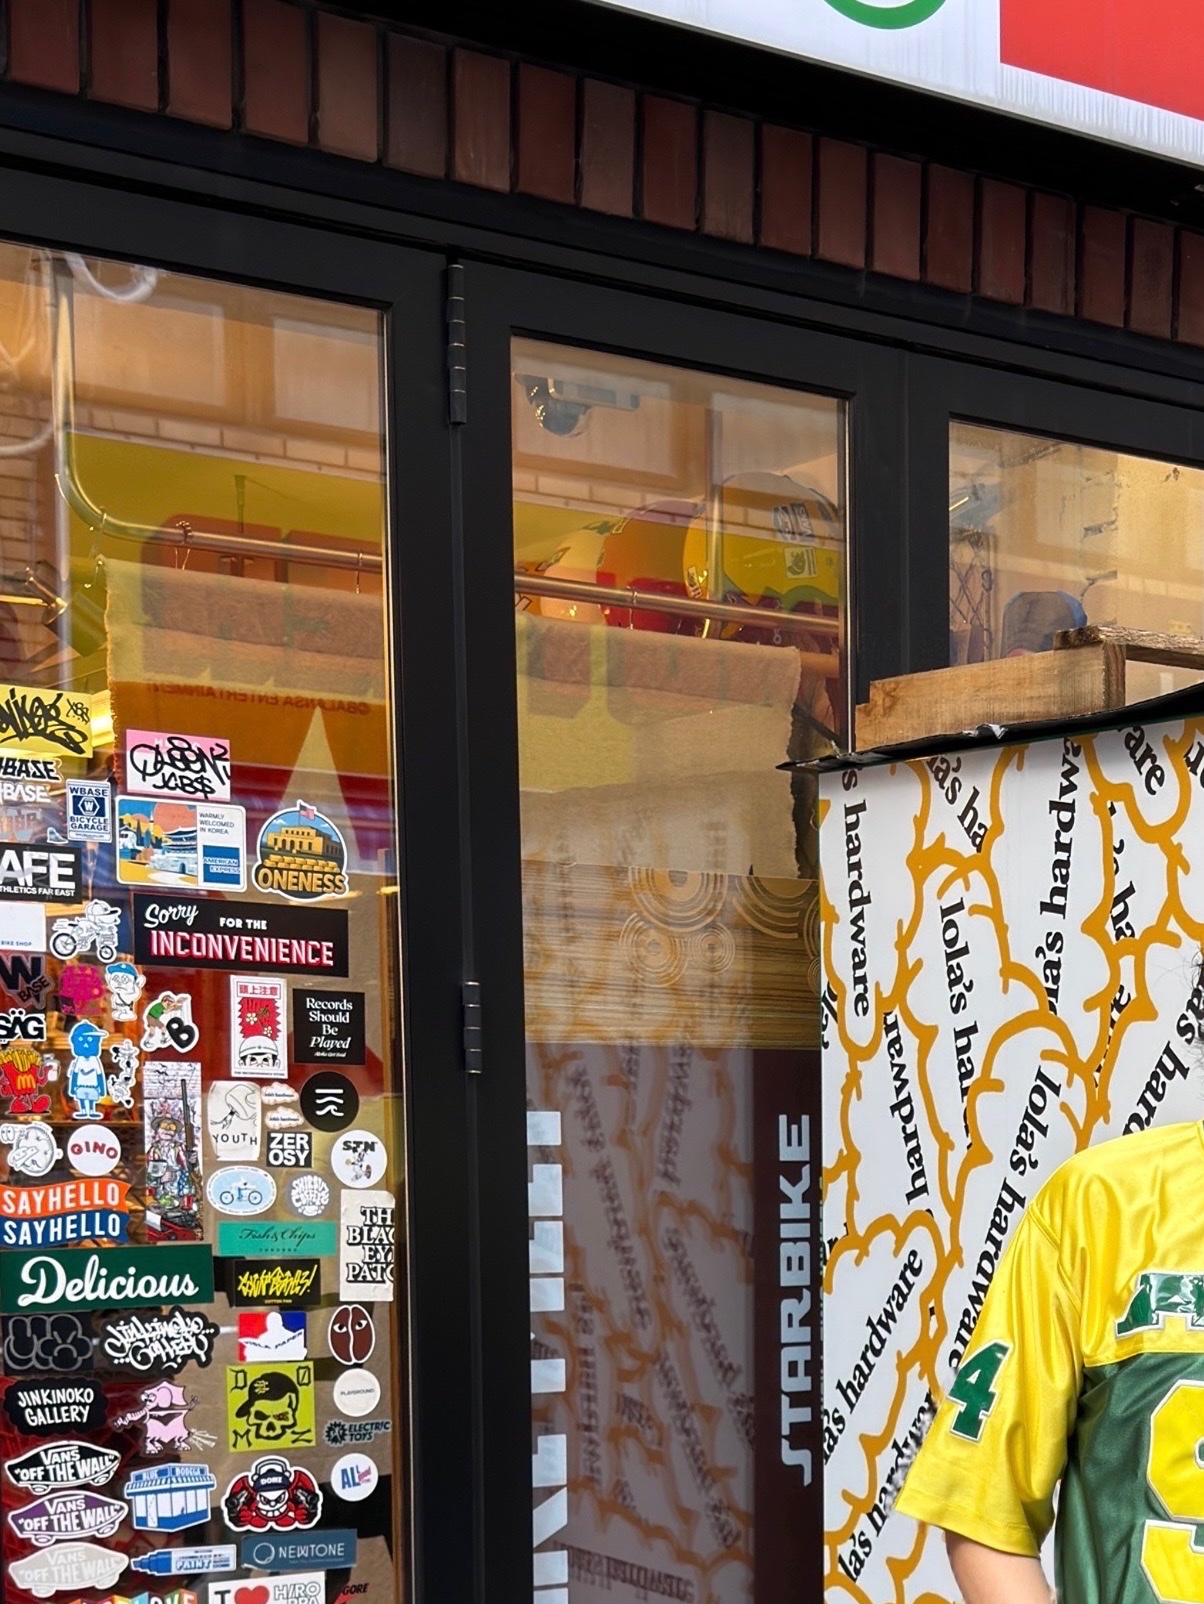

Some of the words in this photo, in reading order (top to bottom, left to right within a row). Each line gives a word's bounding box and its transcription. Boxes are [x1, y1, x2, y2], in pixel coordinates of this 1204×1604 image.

[69, 786, 108, 797] WBASE
[69, 815, 109, 825] BICYCLE
[200, 812, 225, 820] WARMLY
[200, 820, 235, 828] WELCOMED
[70, 823, 109, 832] GARAGE
[203, 857, 239, 866] AMERICAN
[210, 866, 240, 874] EXPRESS
[257, 868, 346, 893] ONENESS
[37, 887, 54, 896] FAR
[54, 889, 75, 897] EAST
[143, 903, 199, 929] Sorry
[219, 917, 243, 930] FOR
[246, 918, 268, 931] THE
[843, 799, 872, 1017] hardware
[150, 930, 334, 967] INCONVENIENCE
[939, 896, 977, 1016] lola's
[17, 976, 49, 1001] BASE
[306, 997, 353, 1011] Records
[309, 1010, 350, 1024] Should
[322, 1024, 339, 1036] Be
[309, 1036, 351, 1051] Played
[1008, 1065, 1062, 1177] lola's
[213, 1133, 258, 1146] YOUTH
[270, 1133, 310, 1149] ZER
[268, 1149, 310, 1166] OSY
[2, 1182, 120, 1216] SAYHELLO
[361, 1206, 394, 1226] TH
[3, 1213, 121, 1246] SAYHELLO
[362, 1245, 394, 1264] EY
[17, 1254, 199, 1307] Delicious
[779, 1114, 812, 1487] STARBIKE
[835, 1247, 924, 1414] hardware
[17, 1387, 94, 1408] JINKINOKO
[947, 1340, 1015, 1444] 4
[25, 1405, 90, 1427] GALLERY
[349, 1420, 391, 1432] ELECTRIC
[349, 1431, 373, 1442] TOYS
[39, 1446, 81, 1465] VANS
[49, 1463, 78, 1481] THE
[44, 1495, 86, 1515] VANS
[52, 1512, 82, 1532] THE
[47, 1547, 86, 1565] VANS
[278, 1542, 345, 1559] NEWTONE
[52, 1565, 81, 1582] THE
[342, 1583, 370, 1595] GORE
